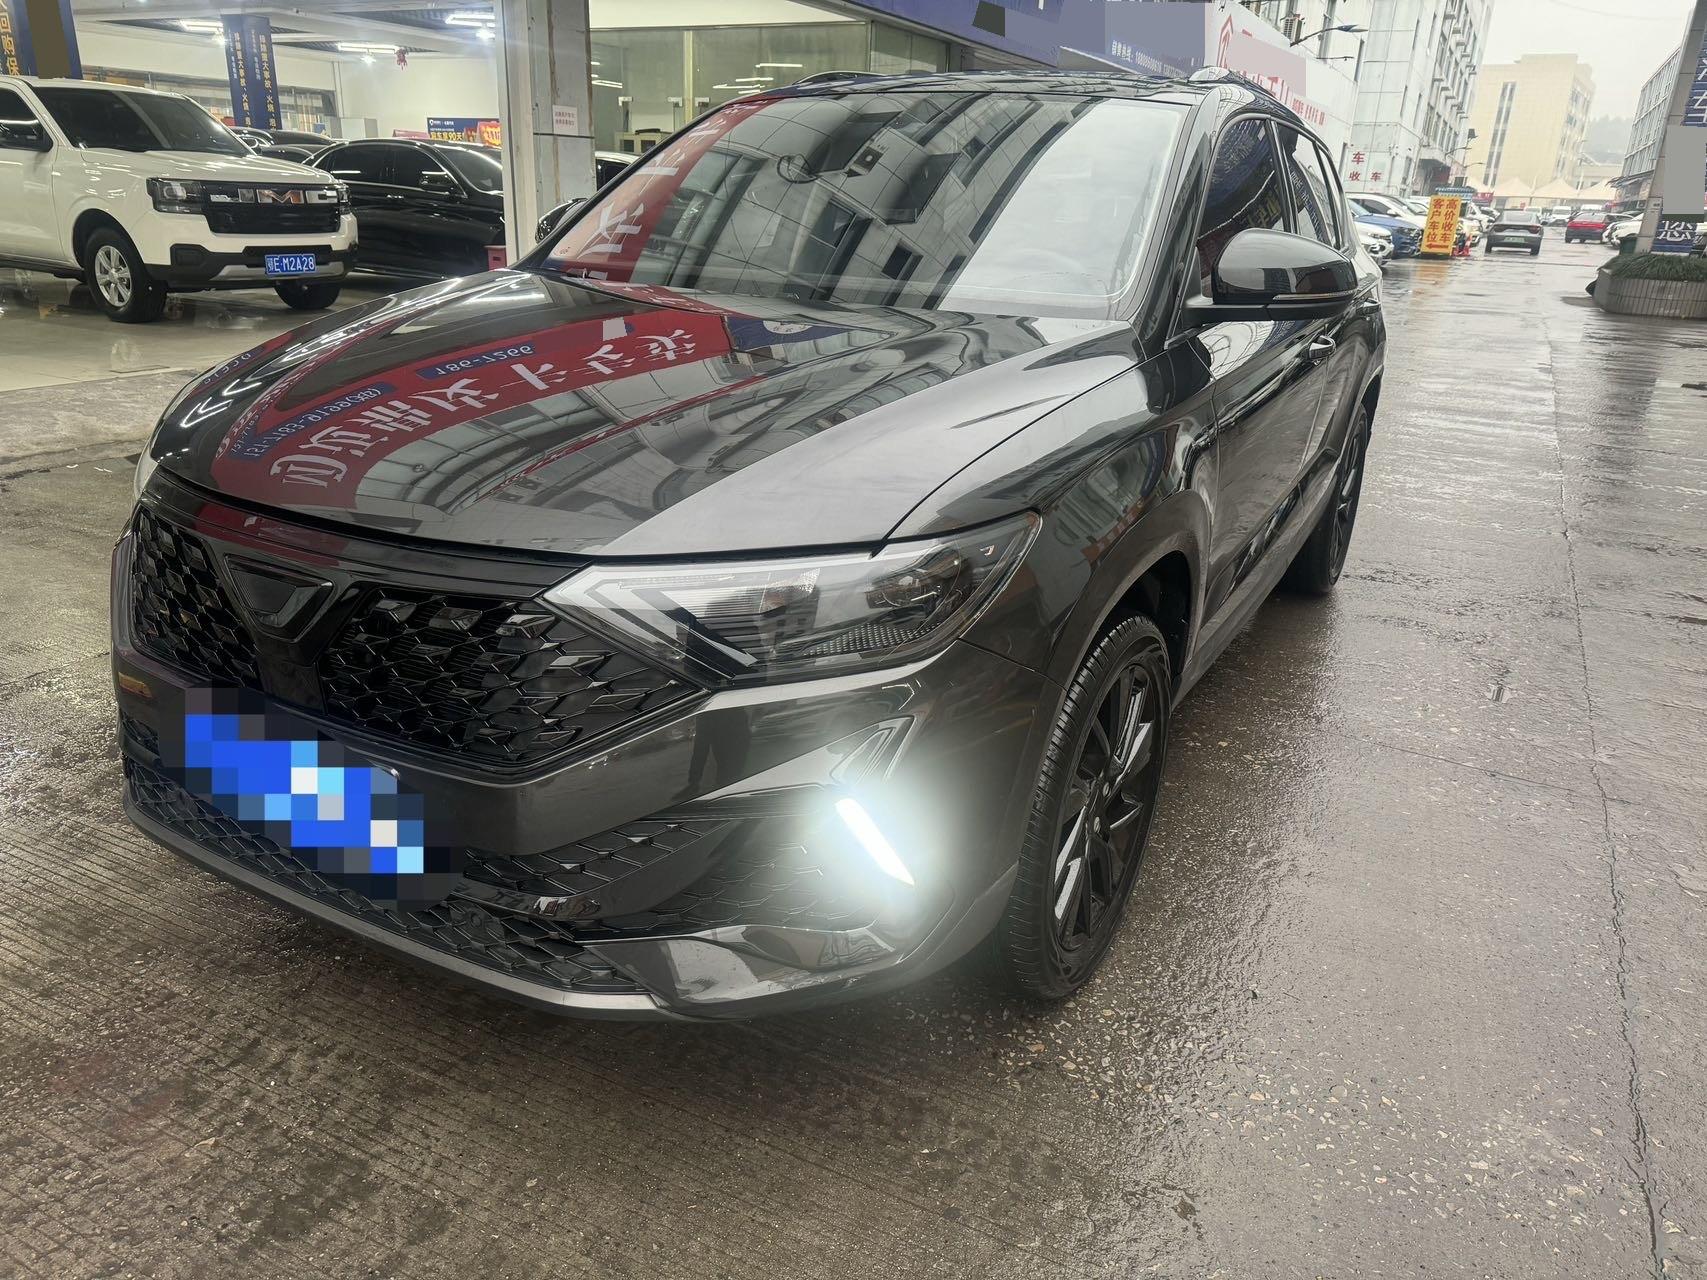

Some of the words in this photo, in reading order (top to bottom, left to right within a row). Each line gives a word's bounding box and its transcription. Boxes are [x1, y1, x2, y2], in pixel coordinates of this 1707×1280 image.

[0, 0, 20, 76] 回购保
[1352, 152, 1365, 164] 车
[1370, 172, 1381, 181] 车
[1427, 199, 1444, 242] 客户车位
[1440, 199, 1458, 243] 高价收车
[1657, 221, 1692, 241] 您
